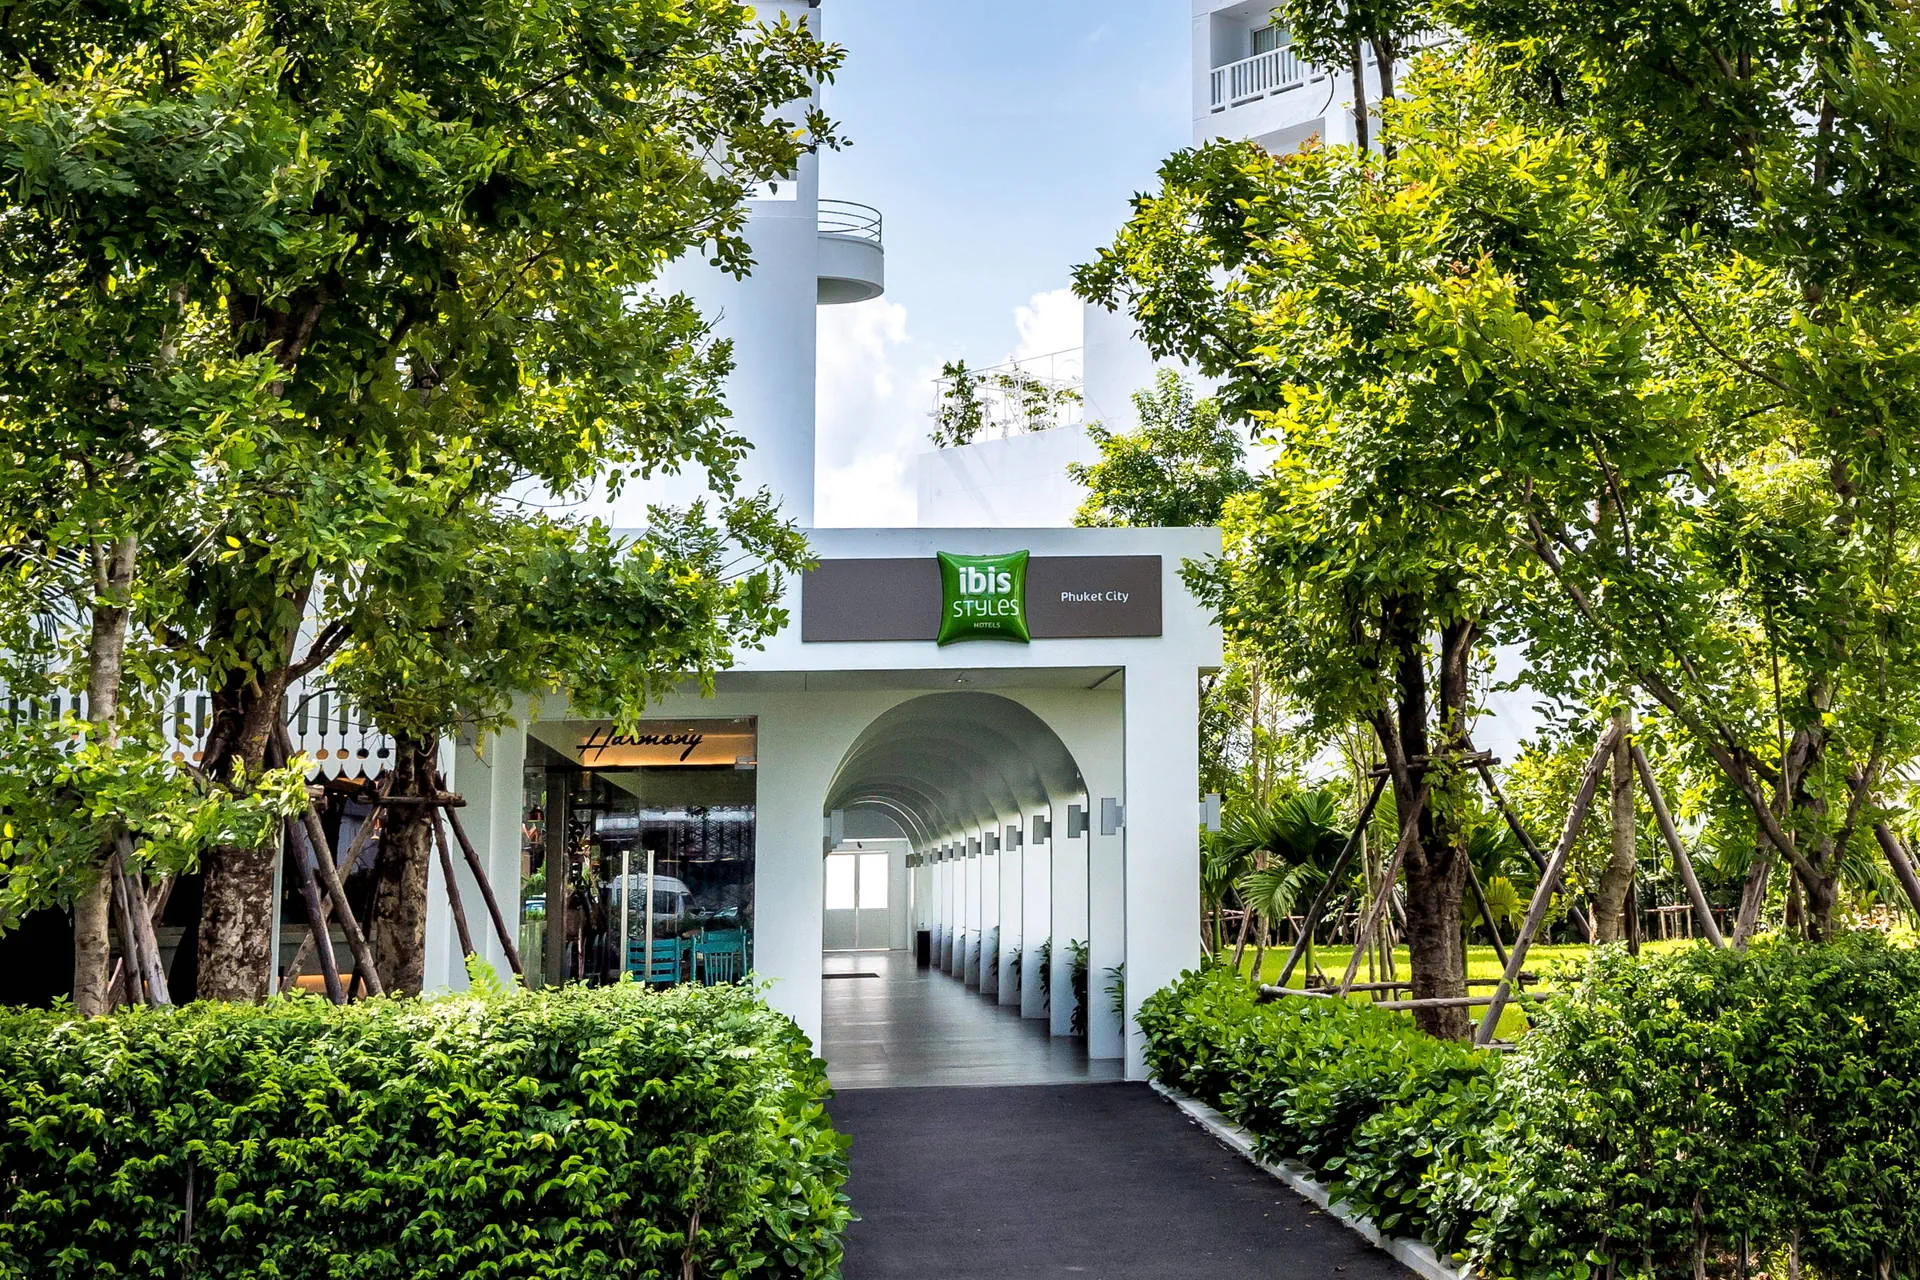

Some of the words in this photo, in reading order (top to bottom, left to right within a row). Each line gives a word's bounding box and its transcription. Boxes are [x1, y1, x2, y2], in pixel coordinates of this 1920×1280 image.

[959, 566, 1012, 595] ibis
[1061, 591, 1103, 602] Phuket
[1105, 590, 1129, 603] City
[576, 725, 703, 762] Harmony
